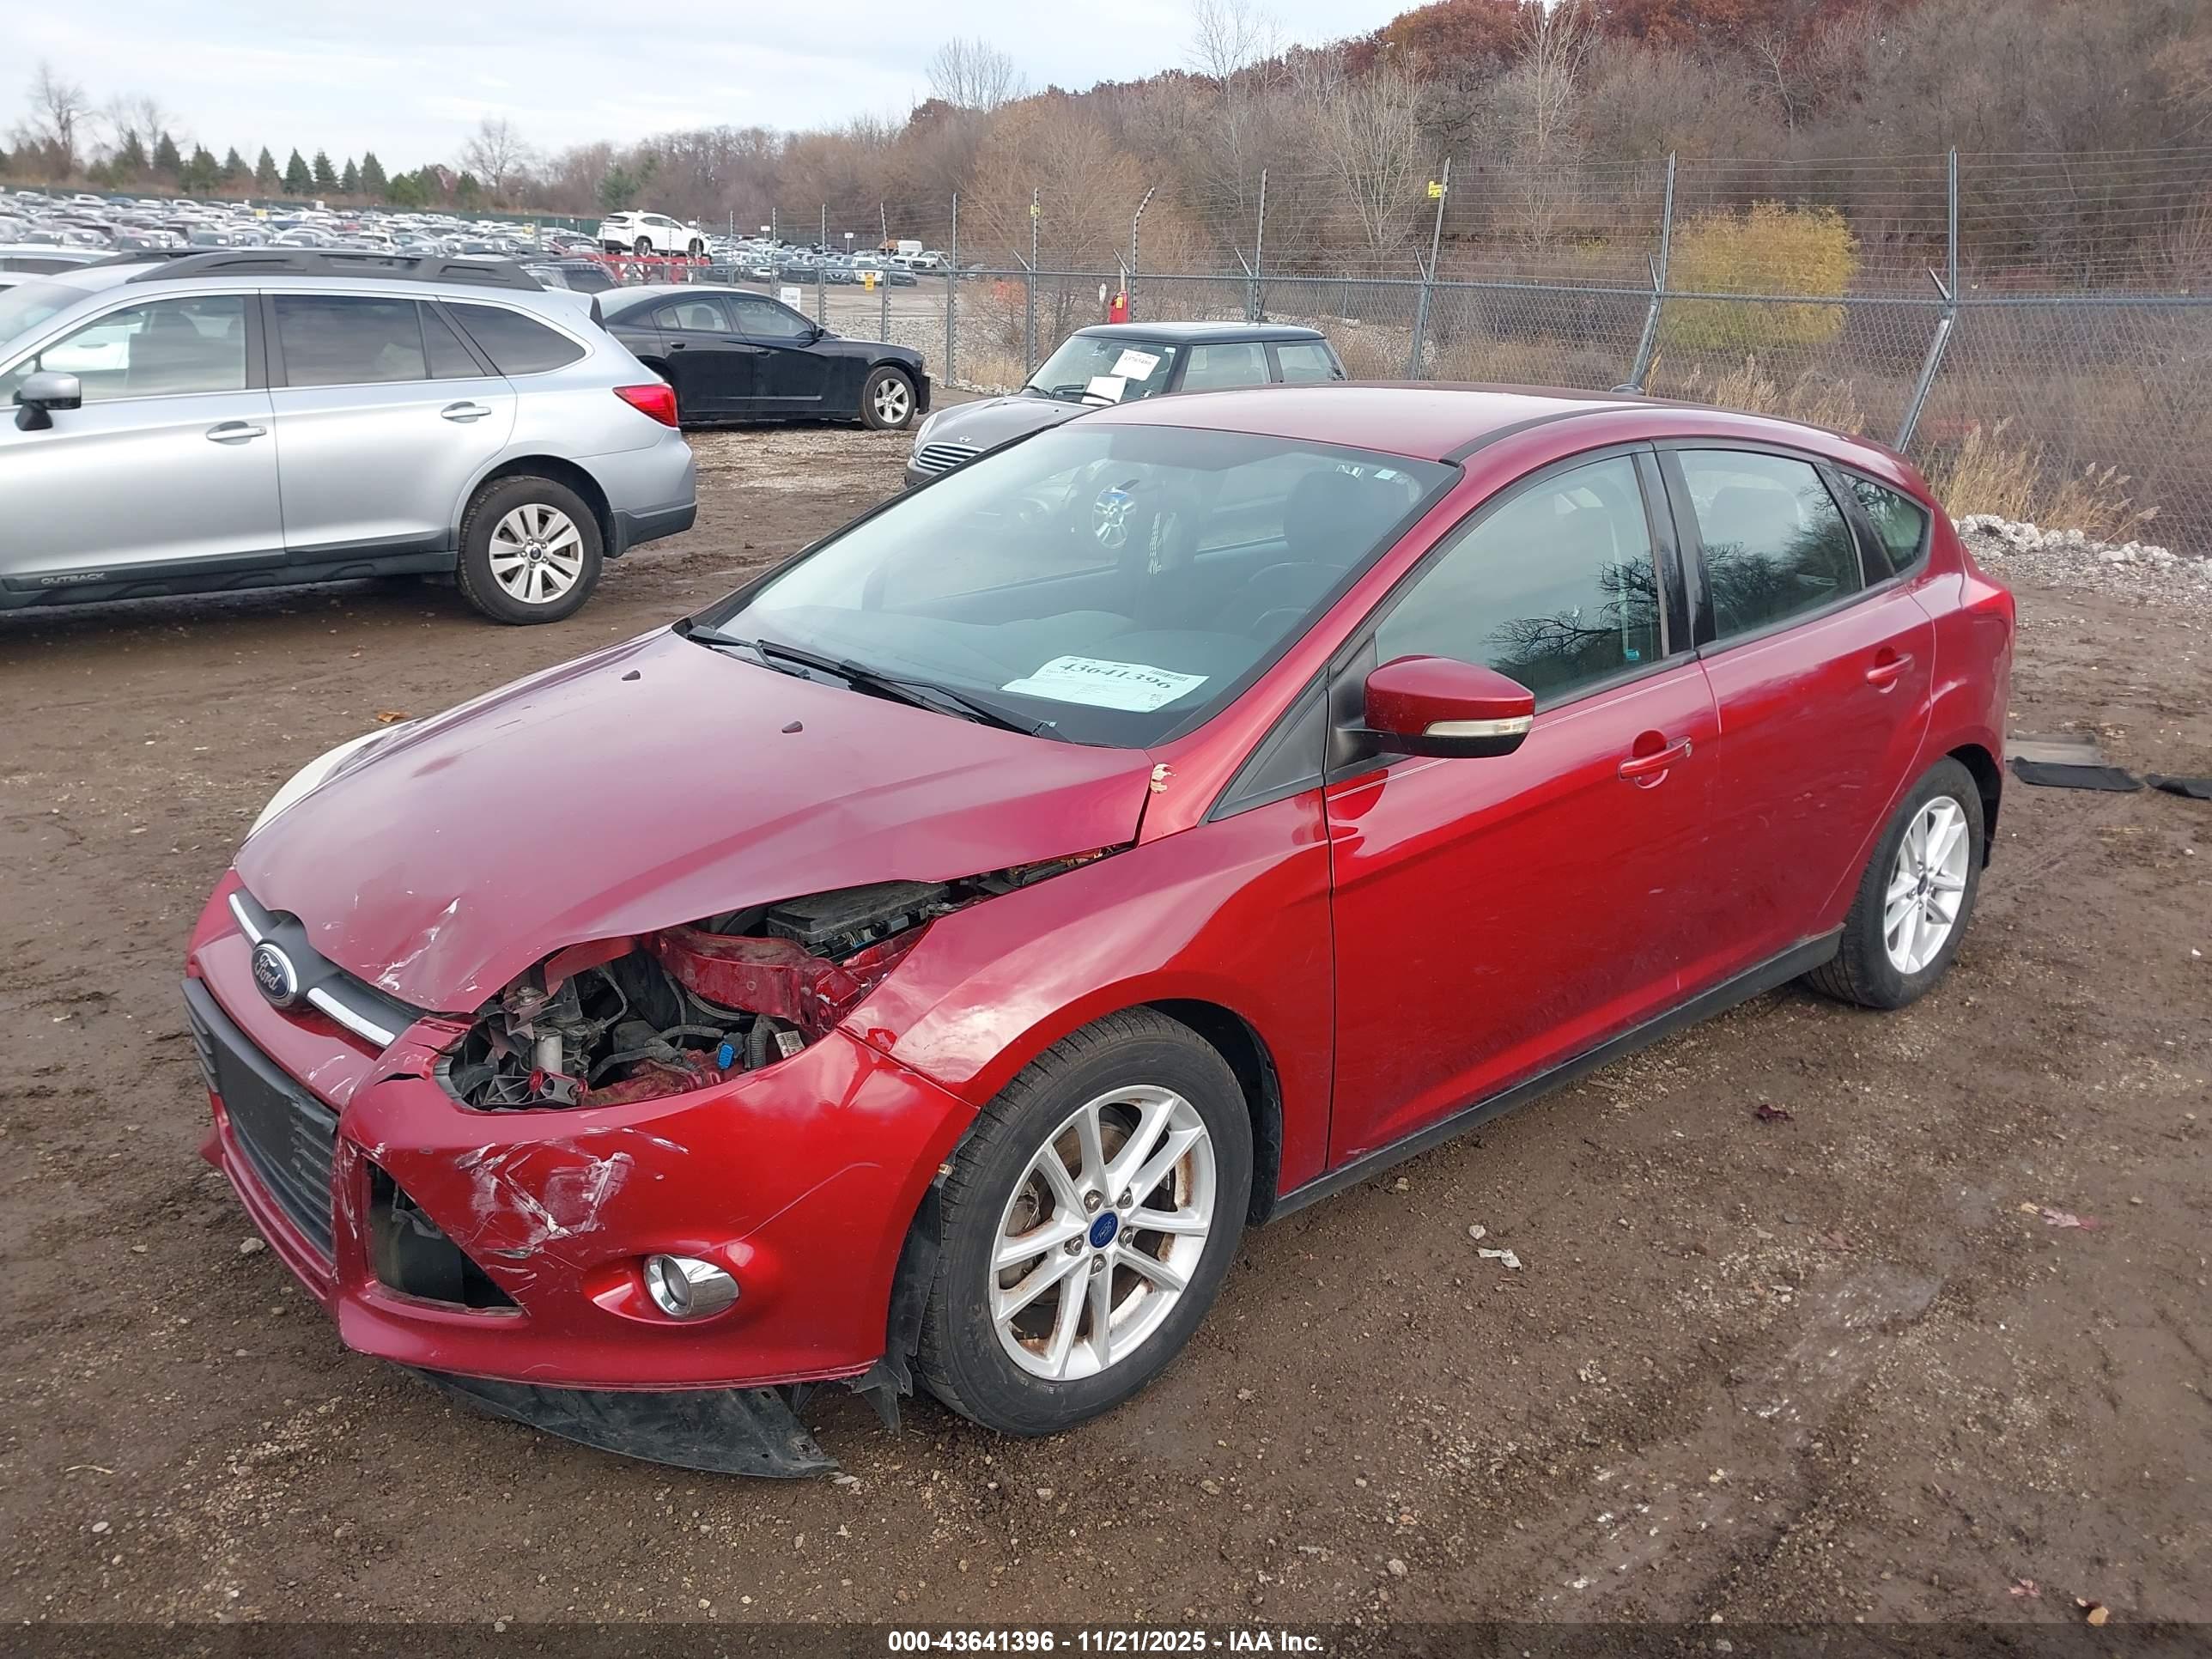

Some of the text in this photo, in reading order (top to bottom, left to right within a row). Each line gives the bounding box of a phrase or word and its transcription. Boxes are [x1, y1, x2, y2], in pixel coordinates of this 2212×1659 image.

[40, 572, 105, 585] OUTBACK
[1059, 663, 1173, 689] 43641396
[255, 952, 282, 990] Ford
